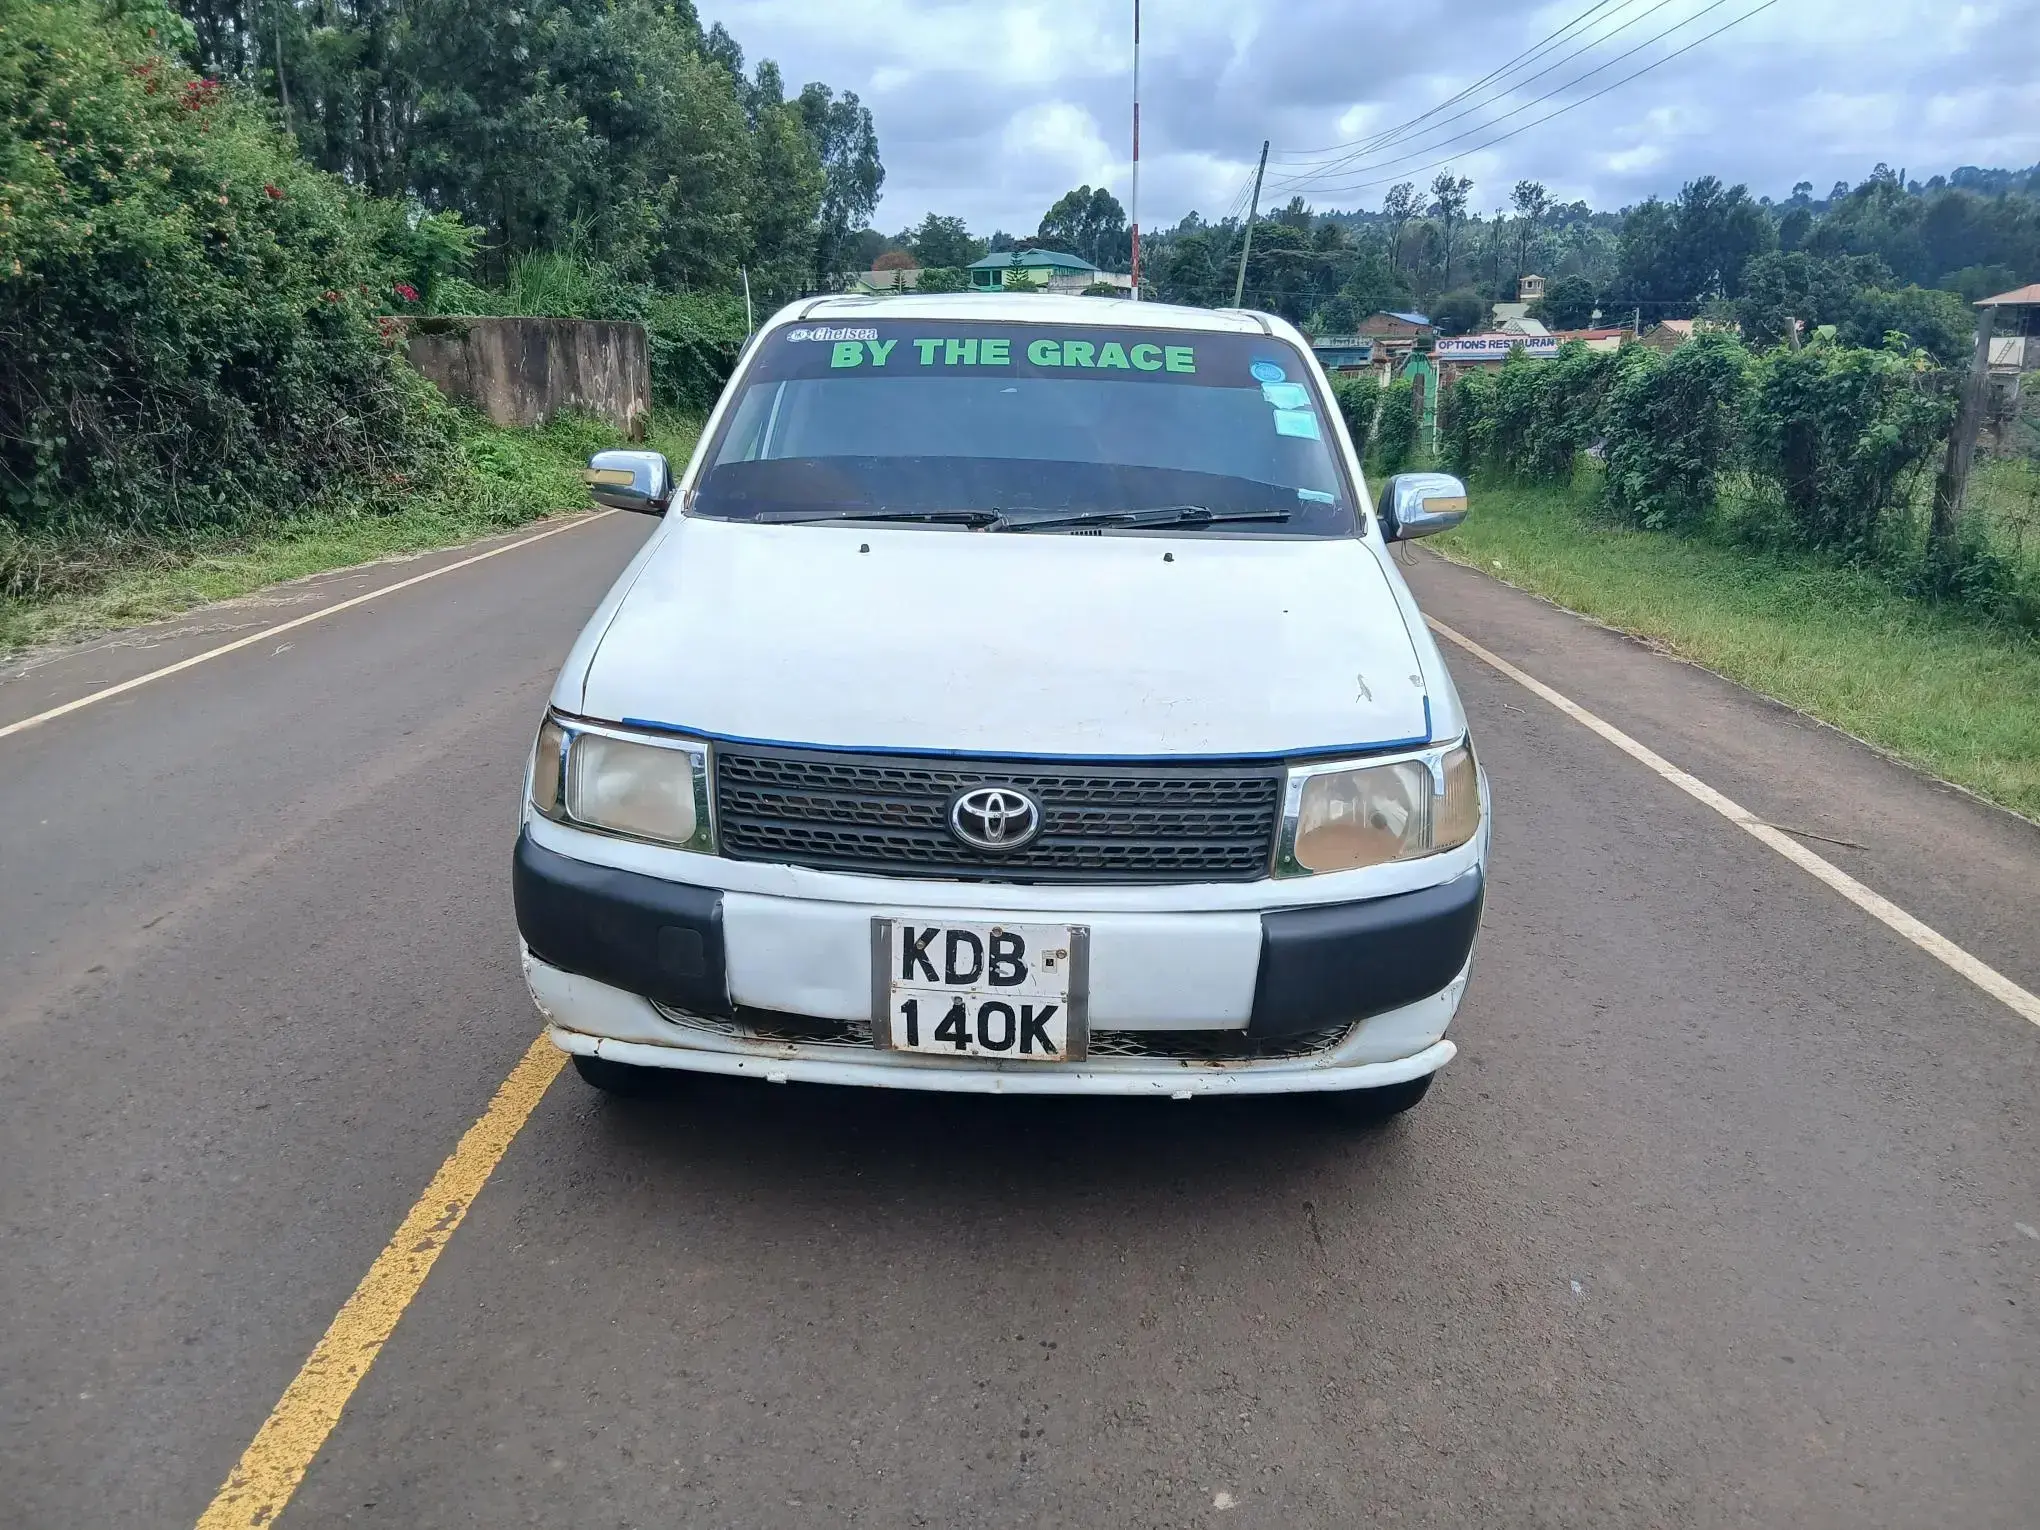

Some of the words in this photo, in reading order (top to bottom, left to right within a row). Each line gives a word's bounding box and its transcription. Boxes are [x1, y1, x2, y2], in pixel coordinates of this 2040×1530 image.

[811, 327, 877, 341] Chelsea
[1439, 340, 1487, 350] OPTIONS
[830, 339, 898, 368] BY
[913, 338, 1011, 366] THE
[1026, 339, 1196, 373] GRACE
[902, 926, 1029, 987] KDB
[900, 996, 1060, 1055] 140K
